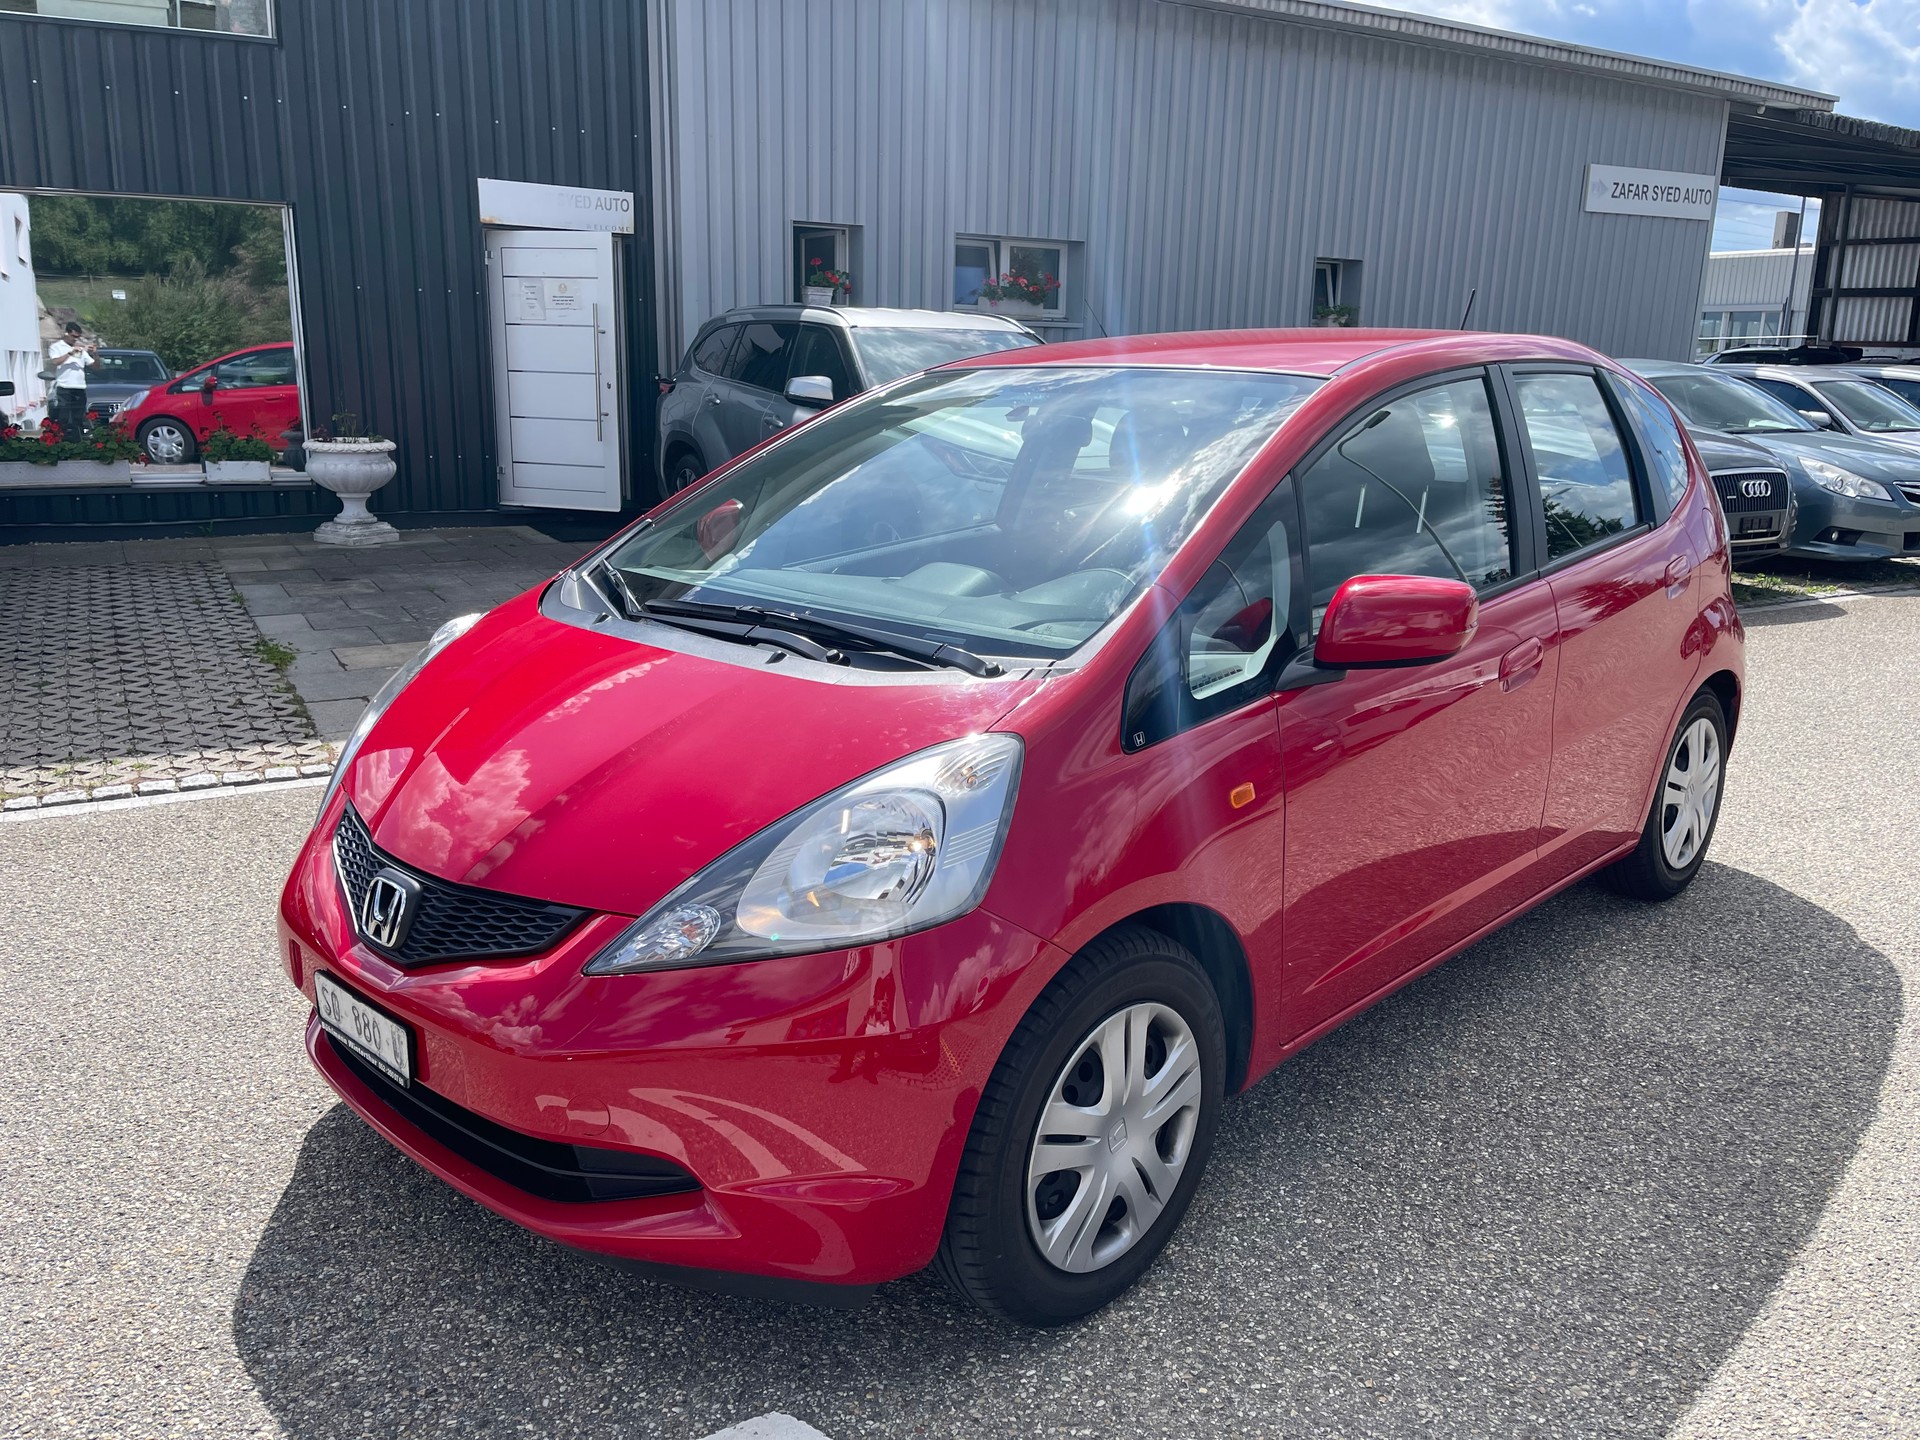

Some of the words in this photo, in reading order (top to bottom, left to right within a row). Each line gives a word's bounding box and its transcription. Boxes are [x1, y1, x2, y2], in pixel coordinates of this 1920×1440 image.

[594, 197, 630, 213] AUTO
[1611, 182, 1649, 201] ZAFAR
[1651, 185, 1681, 203] SYED
[1682, 188, 1712, 205] AUTO
[351, 1004, 382, 1051] 880
